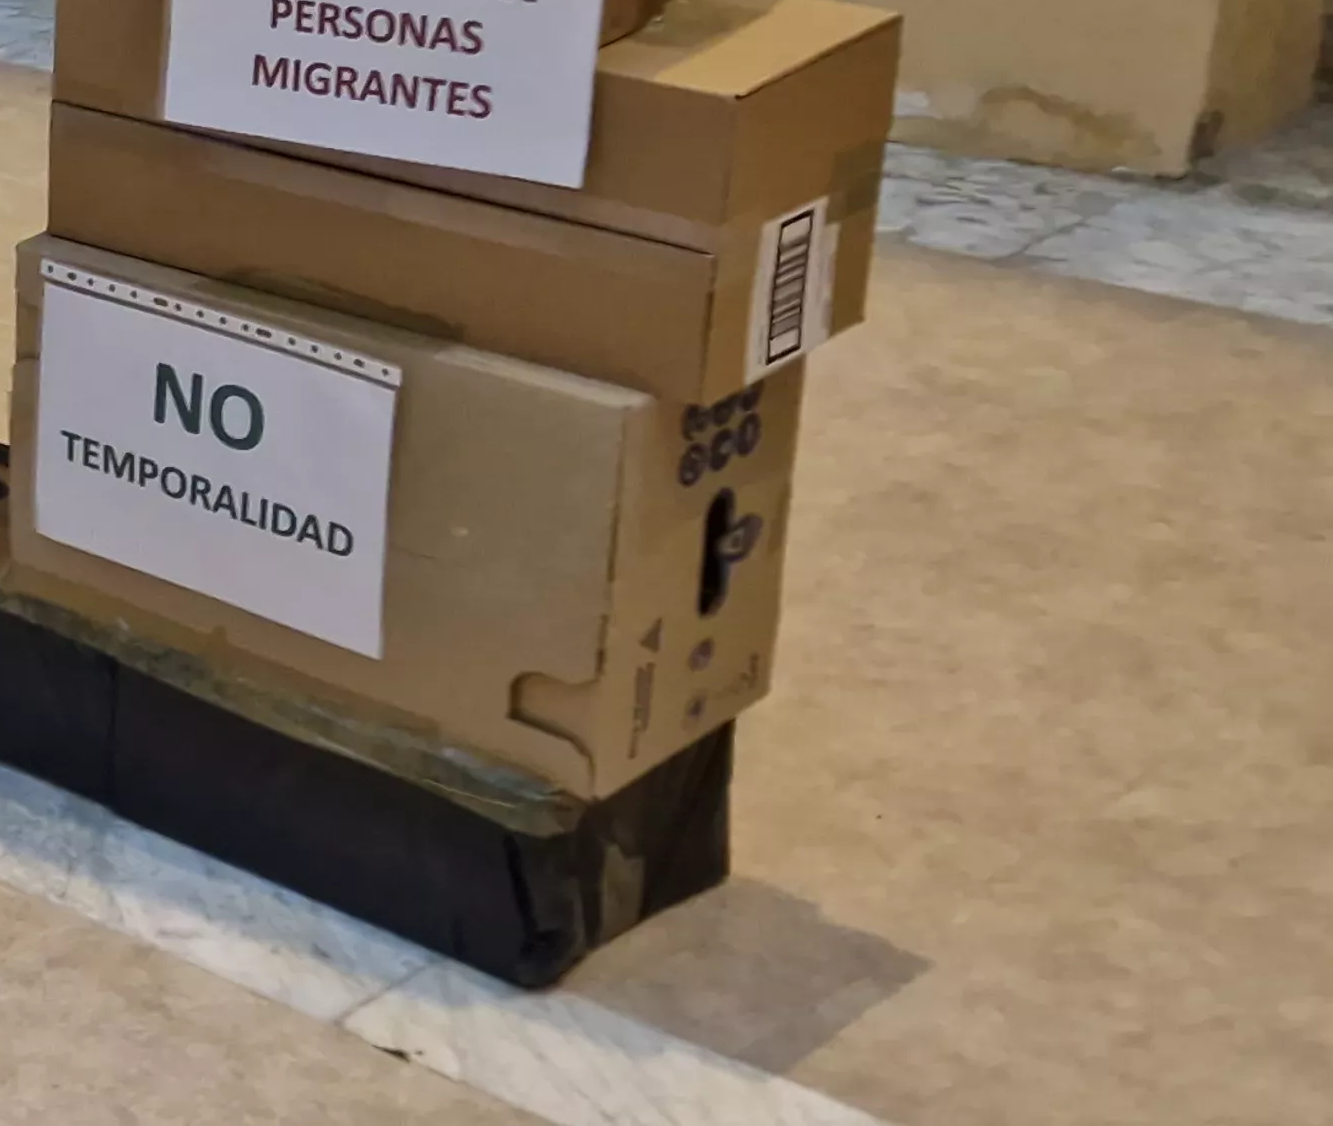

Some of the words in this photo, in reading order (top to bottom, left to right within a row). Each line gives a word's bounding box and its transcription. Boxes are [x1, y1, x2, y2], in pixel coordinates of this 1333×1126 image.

[250, 53, 493, 120] MIGRANTES
[153, 362, 265, 451] NO
[60, 429, 354, 558] TEMPORALIDAD
